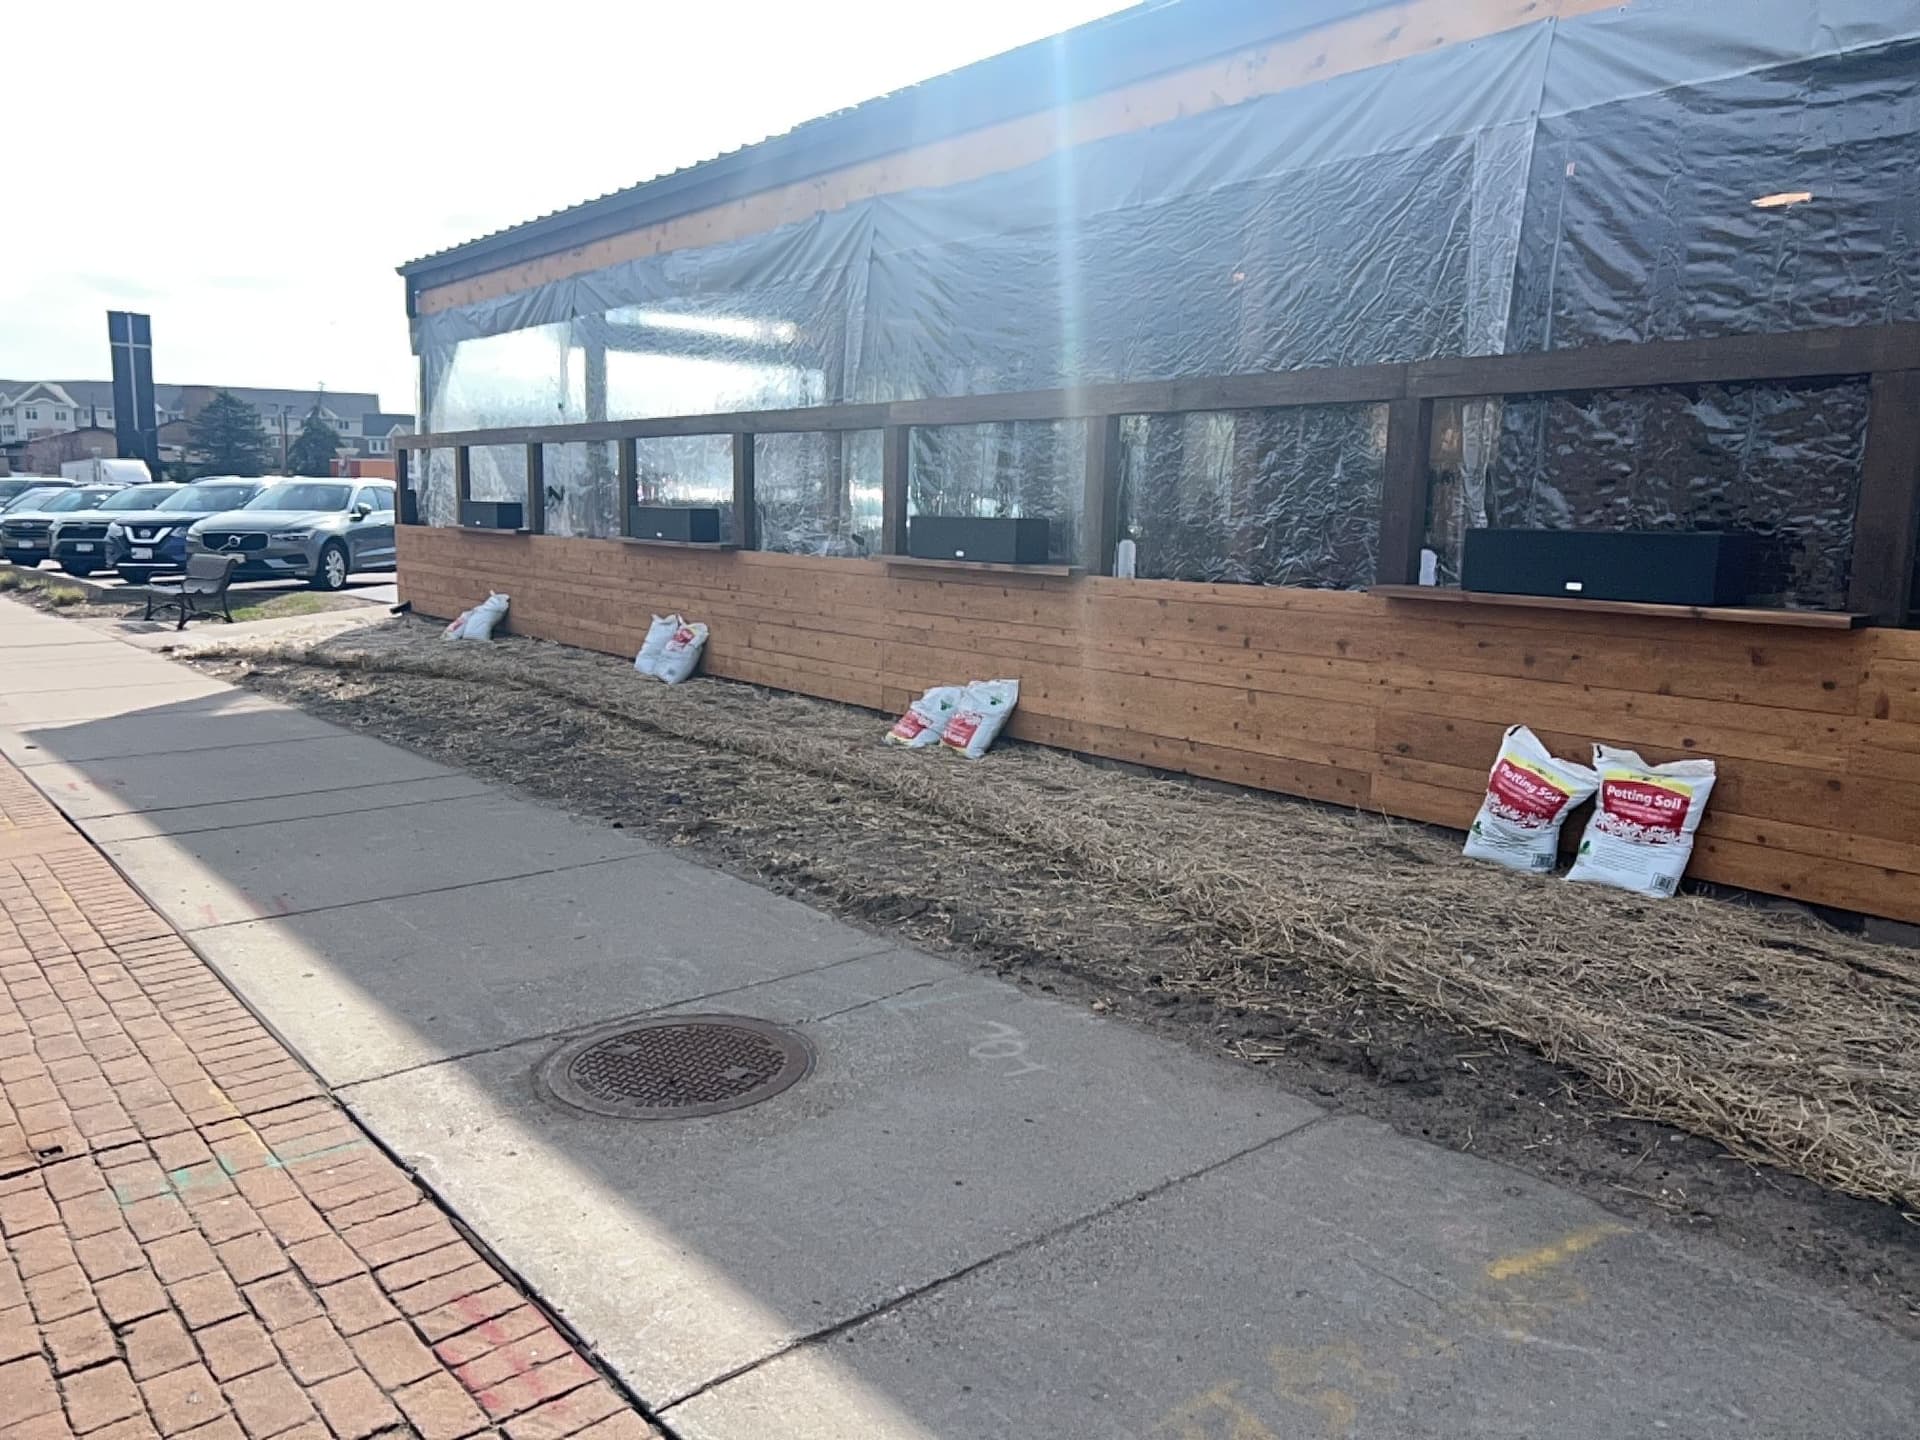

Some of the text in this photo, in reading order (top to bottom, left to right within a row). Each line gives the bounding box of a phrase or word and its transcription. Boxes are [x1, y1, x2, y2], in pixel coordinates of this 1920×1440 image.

[1499, 763, 1537, 793] Potting
[1537, 786, 1561, 802] Soil
[1606, 785, 1652, 806] Potting
[1654, 794, 1682, 810] Soil
